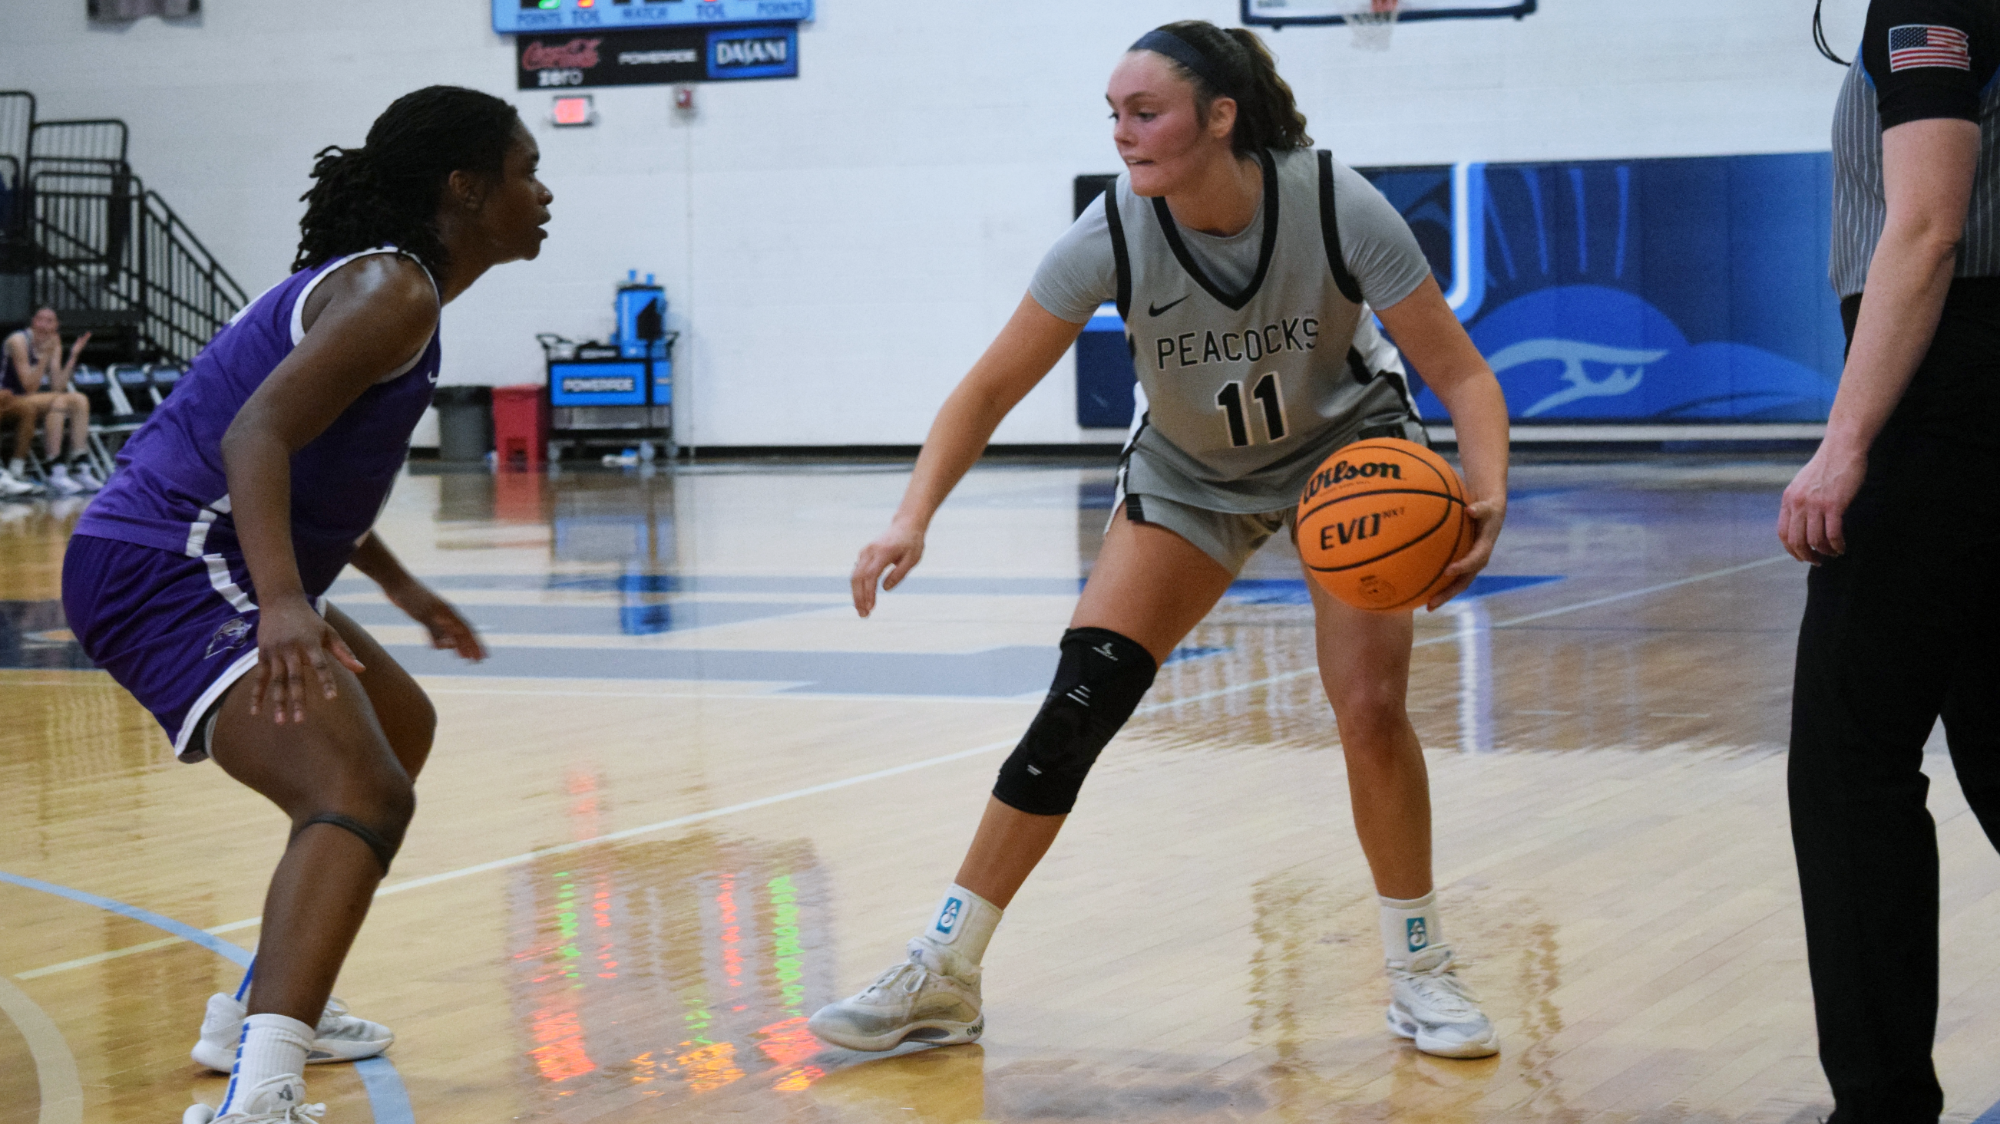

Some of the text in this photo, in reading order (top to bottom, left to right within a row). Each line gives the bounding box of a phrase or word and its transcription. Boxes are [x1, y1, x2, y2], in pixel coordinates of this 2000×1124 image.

[517, 12, 562, 26] POINTS
[622, 7, 669, 20] MATCH
[756, 1, 805, 15] POINTS
[716, 39, 787, 65] DASANI
[538, 69, 584, 87] zero
[1156, 317, 1320, 371] PEACOCKS
[1214, 371, 1289, 447] 11
[1302, 459, 1403, 505] Wilson
[1320, 512, 1381, 551] EVO
